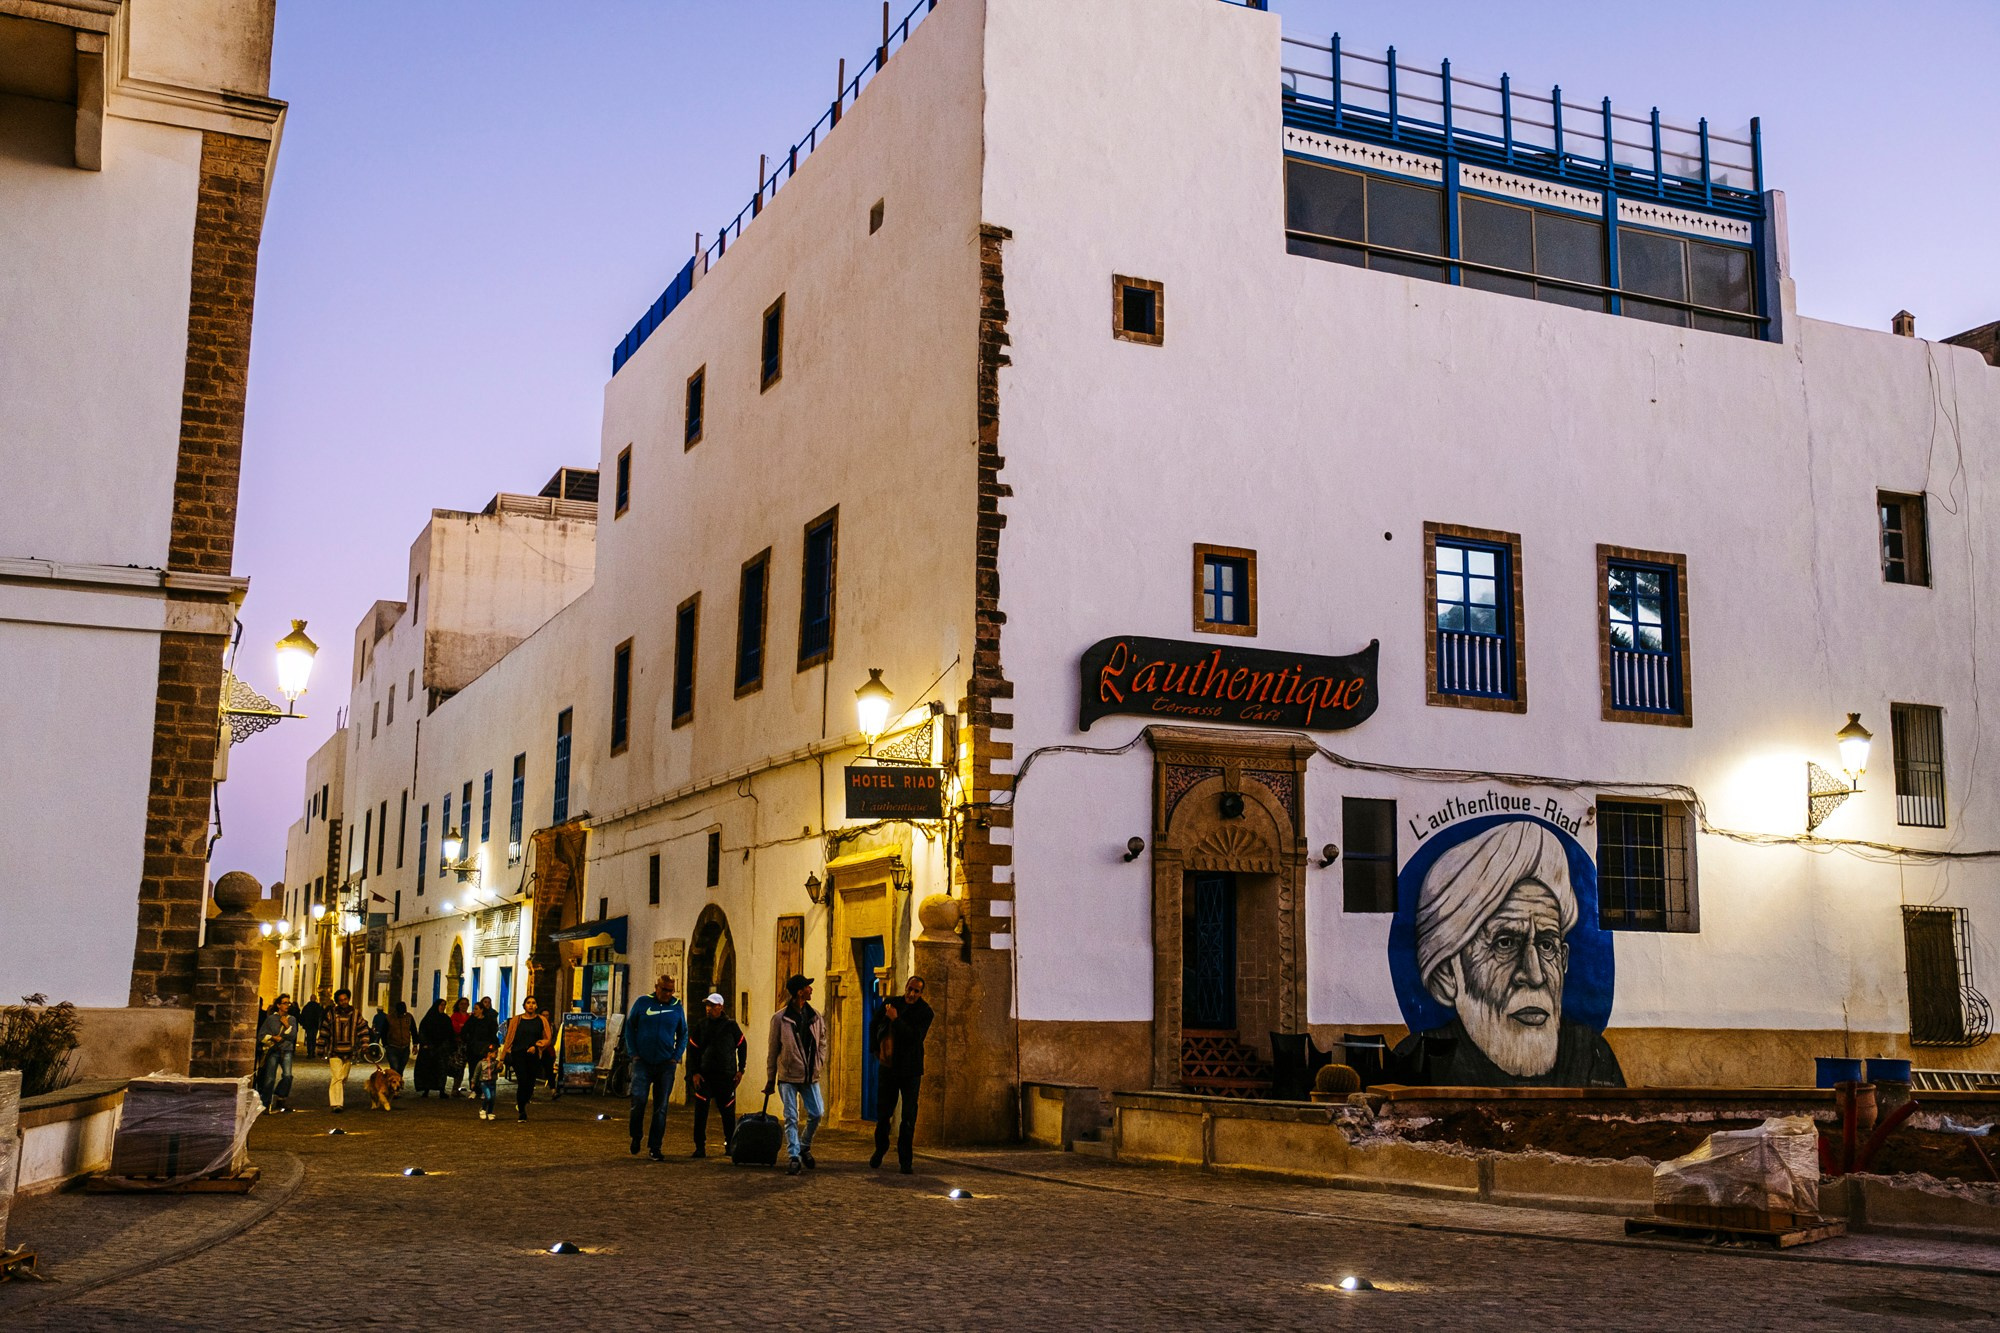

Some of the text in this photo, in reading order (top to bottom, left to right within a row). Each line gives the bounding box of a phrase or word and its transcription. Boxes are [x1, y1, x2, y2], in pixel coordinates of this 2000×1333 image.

[852, 774, 935, 789] HOTEL RIAD
[1543, 797, 1582, 837] Riad
[781, 925, 799, 944] EXPO
